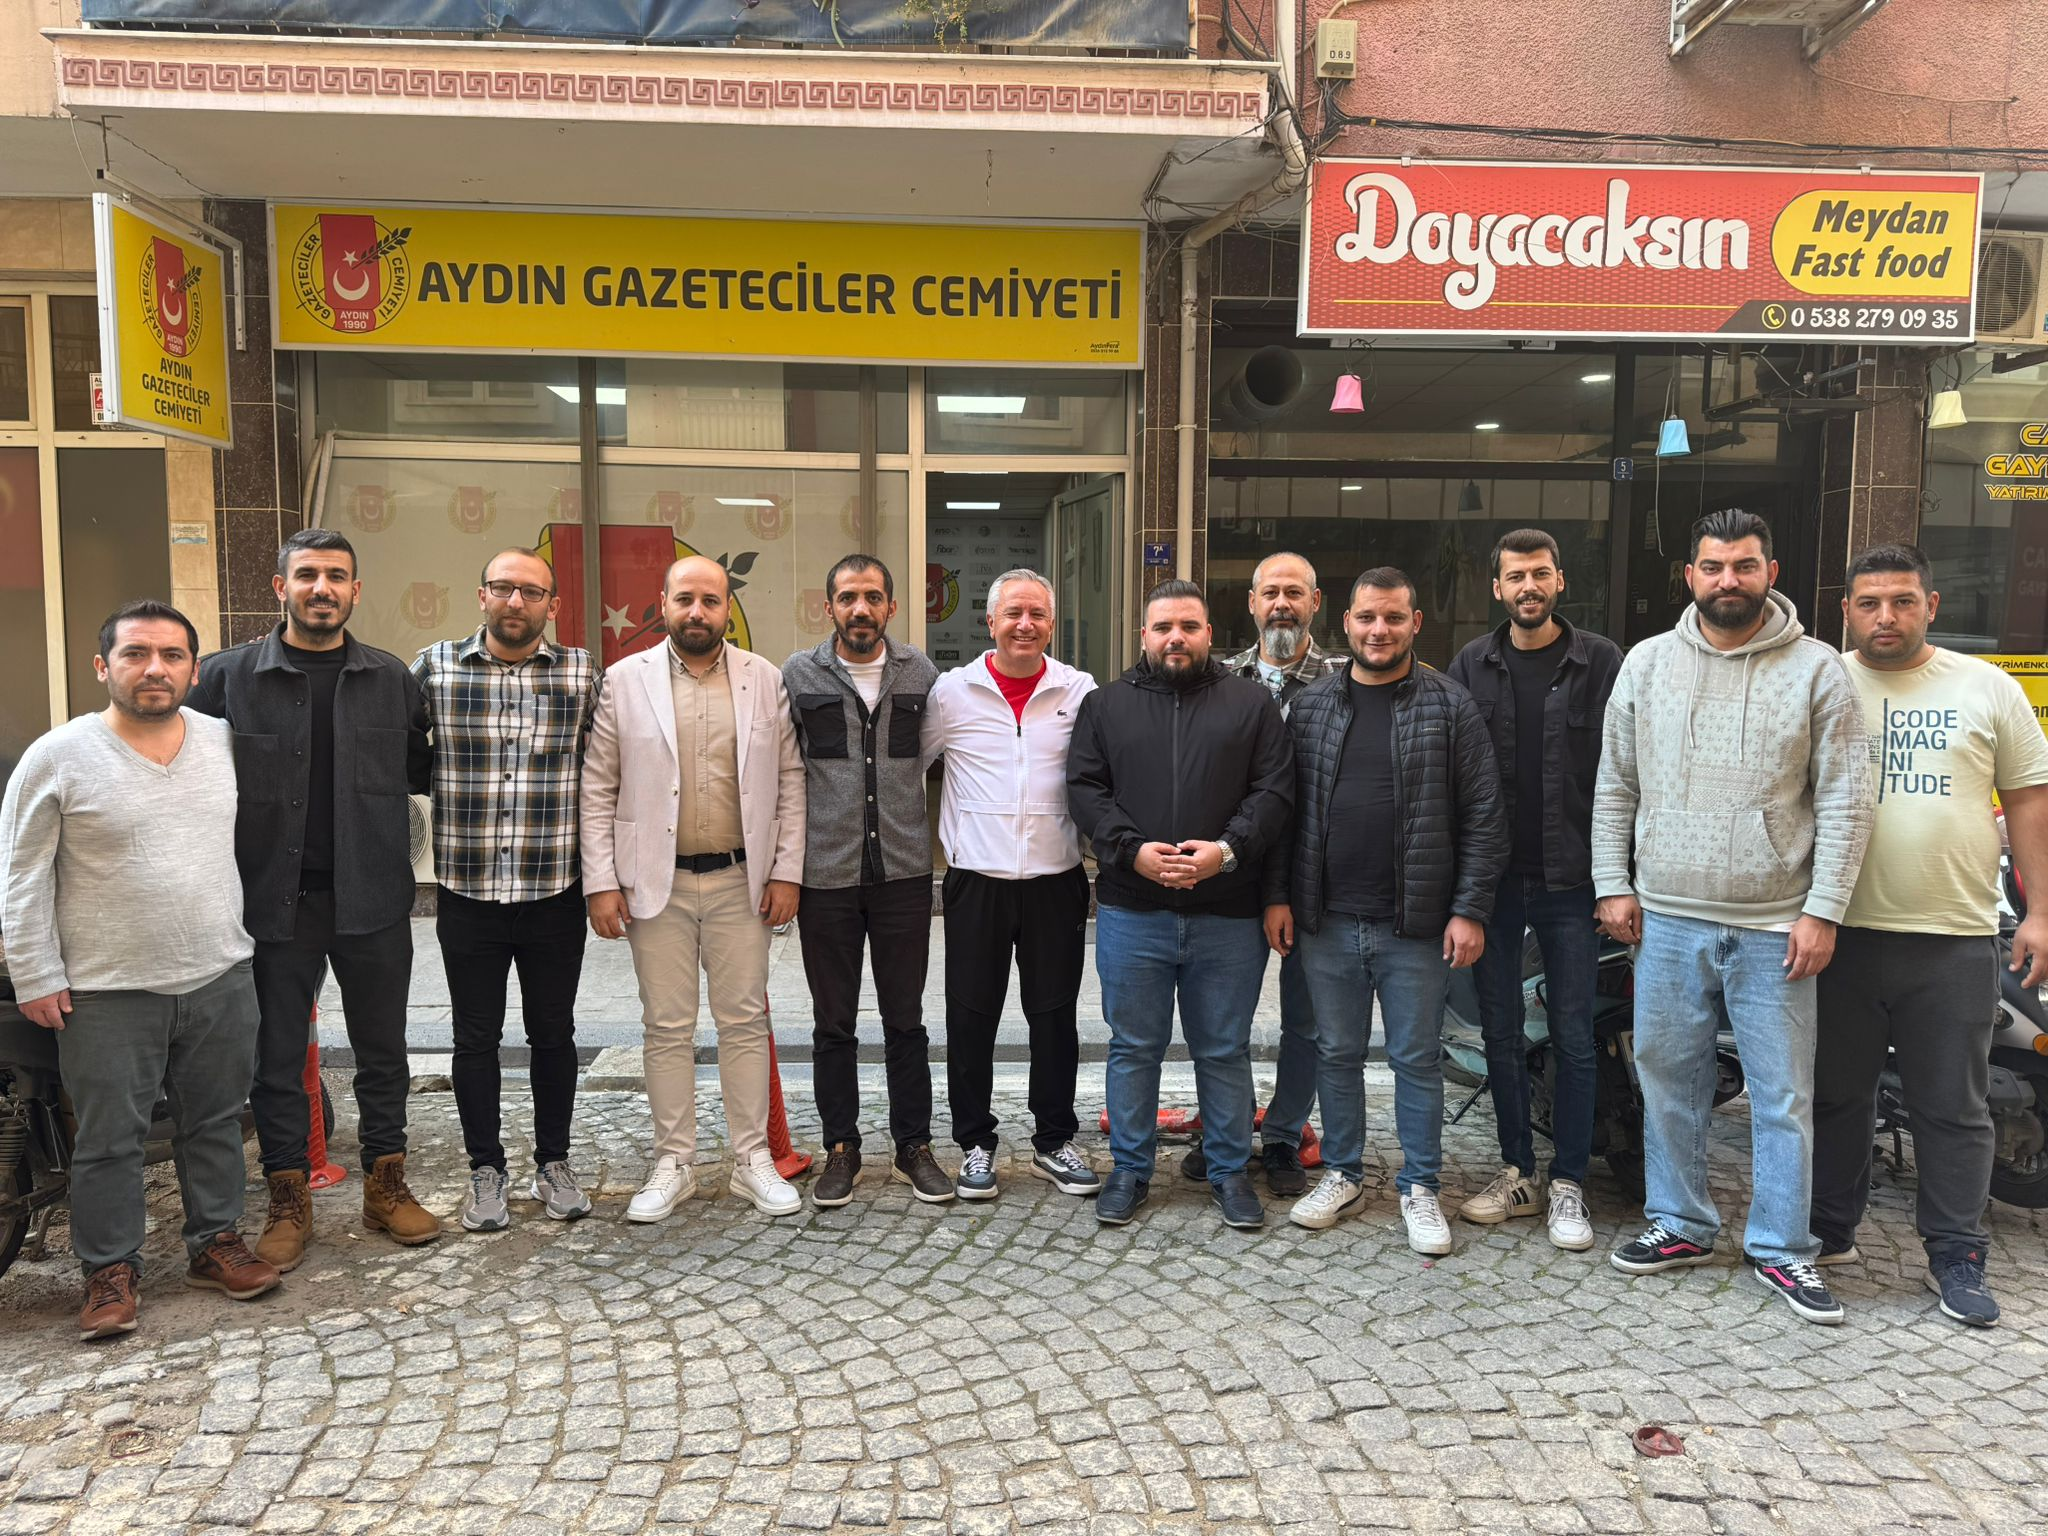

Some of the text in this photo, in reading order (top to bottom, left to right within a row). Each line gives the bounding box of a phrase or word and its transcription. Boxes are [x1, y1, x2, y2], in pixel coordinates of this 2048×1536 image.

[1812, 199, 1949, 242] Meydan
[1334, 172, 1750, 311] Doyacaksın
[1790, 244, 1952, 279] Fast food
[298, 233, 331, 319] GAZETECİLER
[378, 257, 406, 320] CEMİYETİ
[417, 261, 1121, 319] AYDIN GAZETECİLER CEMİYETİ
[340, 311, 369, 319] AYDIN
[343, 320, 367, 329] 1990
[1790, 307, 1958, 329] 0 538 279 09 35
[160, 357, 192, 381] AYDIN
[142, 373, 210, 406] GAZETECİLER
[154, 398, 202, 425] CEMİYETİ
[1620, 461, 1627, 472] 5
[1985, 453, 2048, 478] GAY
[1890, 709, 1957, 729] CODE
[1889, 730, 1947, 750] MAG
[1888, 751, 1913, 771] NI
[1886, 773, 1952, 796] TUDE
